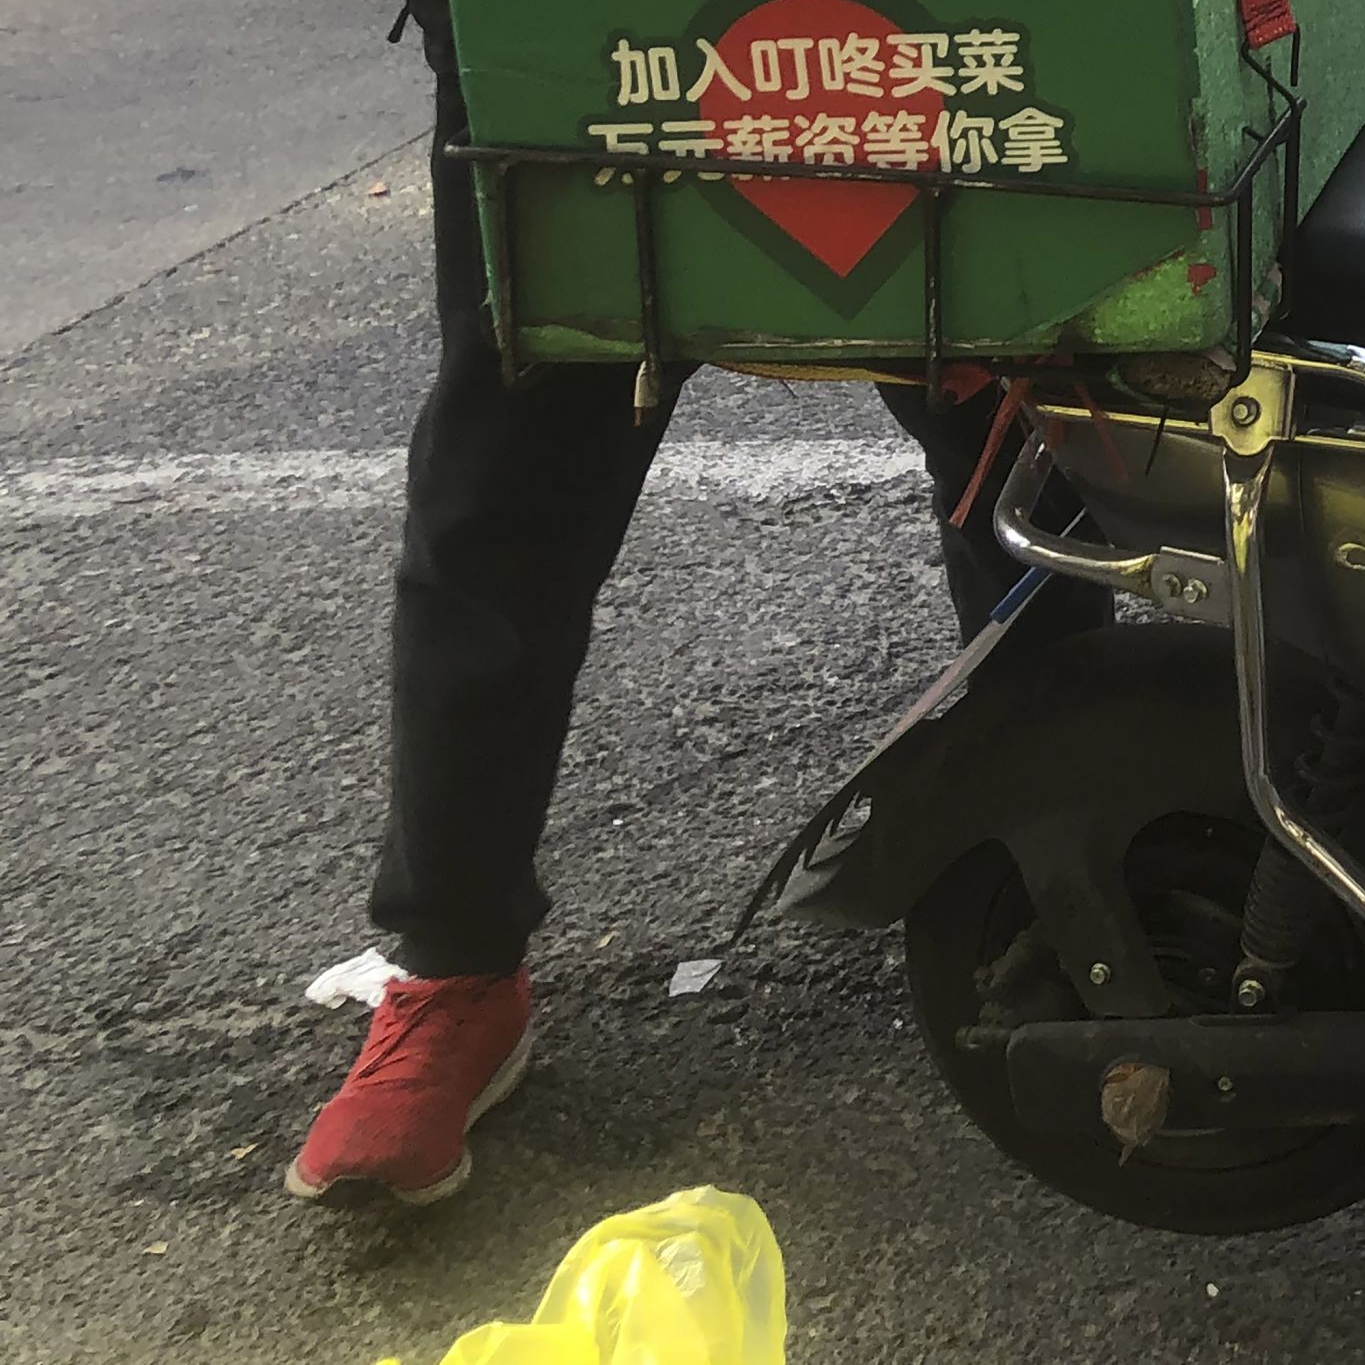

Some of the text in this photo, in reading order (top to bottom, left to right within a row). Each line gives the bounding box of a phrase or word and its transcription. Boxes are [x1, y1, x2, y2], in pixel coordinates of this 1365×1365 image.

[610, 28, 1026, 108] 加入叮咚买菜
